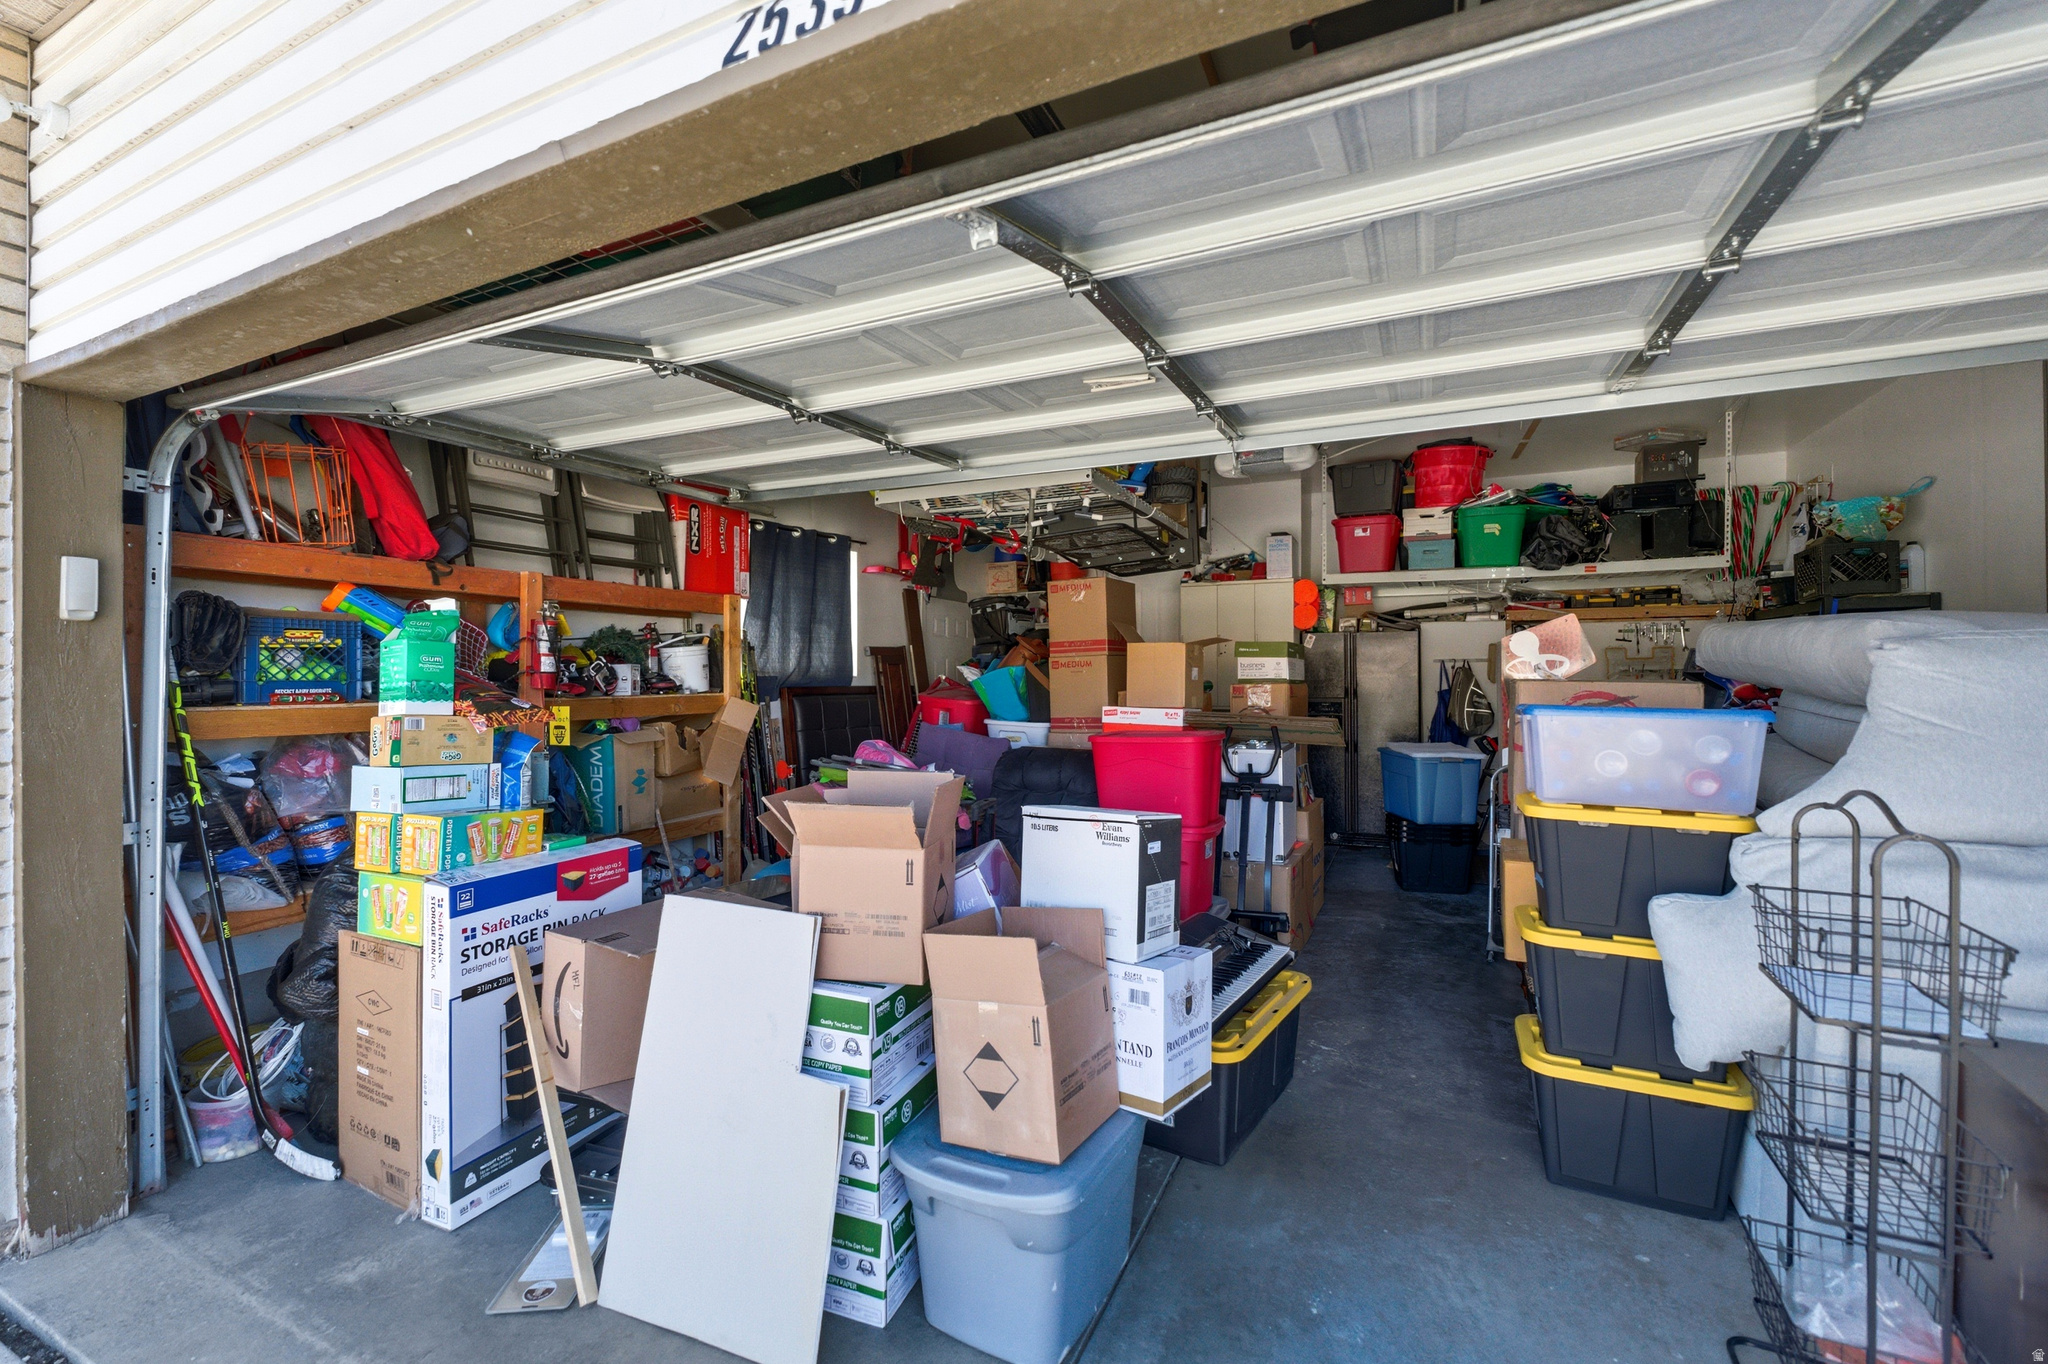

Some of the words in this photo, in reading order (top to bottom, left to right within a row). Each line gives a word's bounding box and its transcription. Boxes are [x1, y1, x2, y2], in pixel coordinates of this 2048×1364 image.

[690, 507, 699, 551] NXR
[1060, 583, 1091, 592] MEDIUM
[1060, 660, 1093, 669] MEDIUM
[590, 746, 604, 828] DIADEM
[445, 819, 453, 854] PROTEIN
[1041, 824, 1059, 832] LITERS
[1095, 831, 1131, 843] Williams
[1102, 822, 1123, 833] Evan
[481, 906, 548, 936] SafeRacks
[460, 928, 539, 964] STORAGE
[461, 958, 497, 977] Designed
[498, 955, 509, 965] for
[1116, 1038, 1153, 1059] NTAND
[811, 1059, 825, 1069] COPY
[825, 1062, 842, 1073] PAPER
